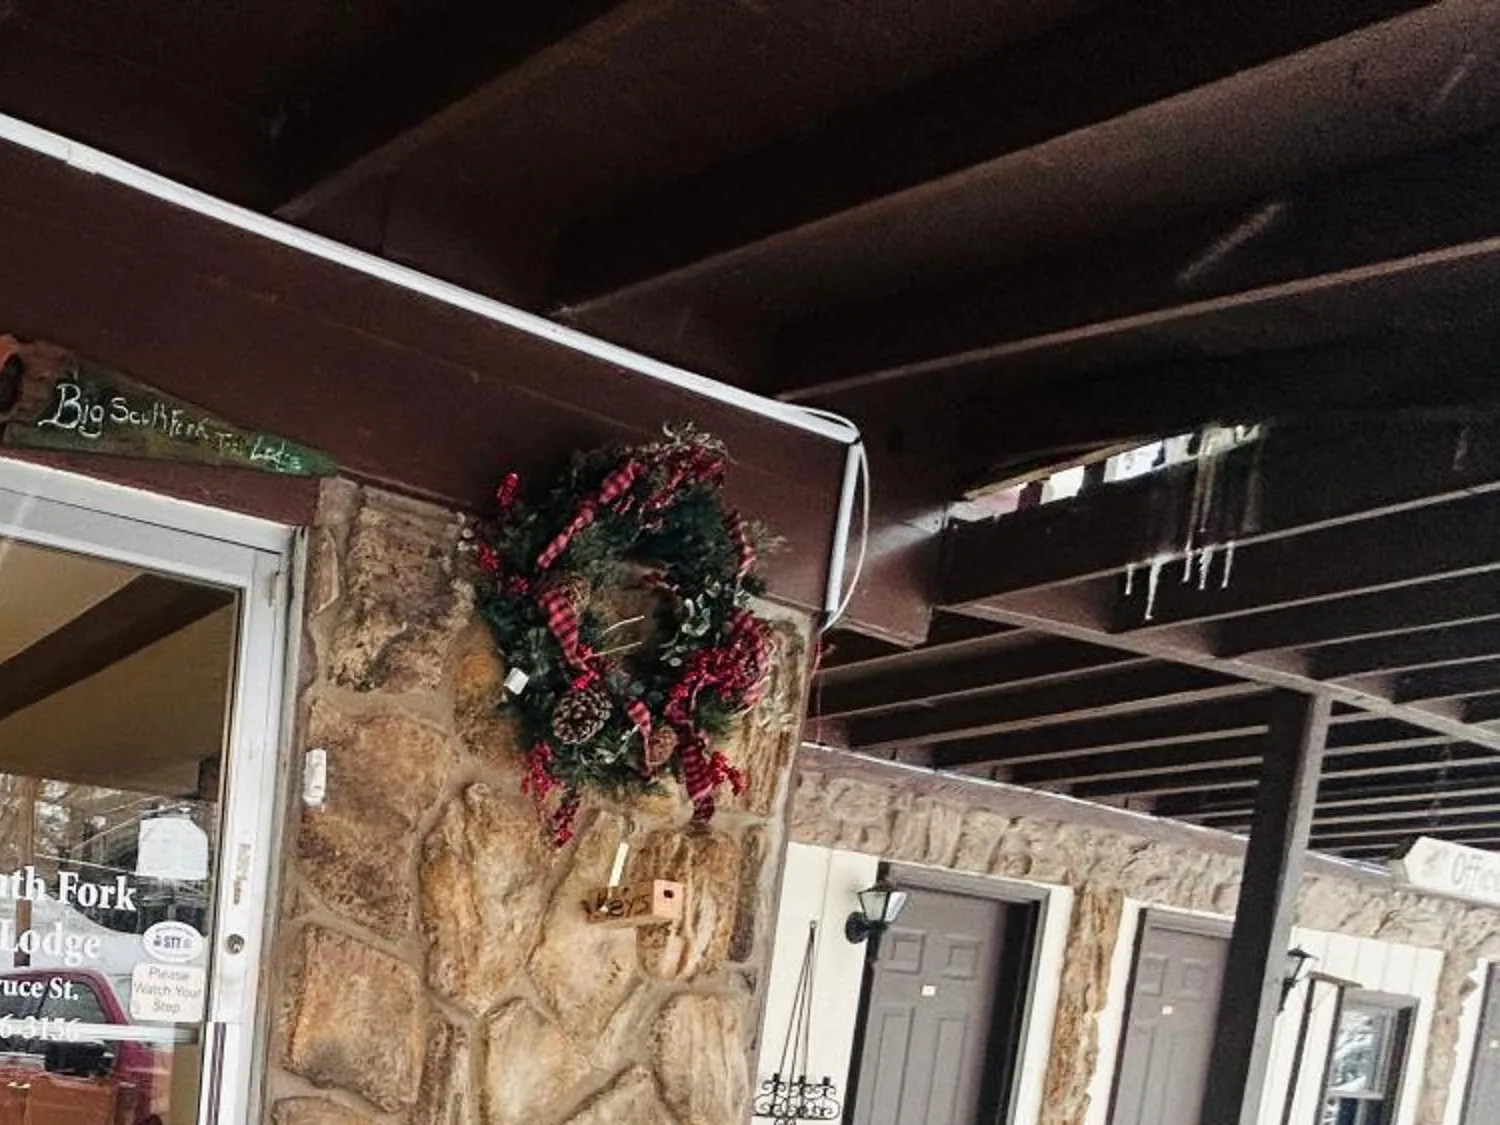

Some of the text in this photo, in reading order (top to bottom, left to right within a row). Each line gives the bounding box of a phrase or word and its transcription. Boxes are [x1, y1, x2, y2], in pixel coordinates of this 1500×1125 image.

[37, 383, 104, 438] Big
[58, 870, 138, 911] Fork
[49, 976, 80, 1001] St.
[133, 981, 171, 996] Watch
[153, 1000, 182, 1015] Step
